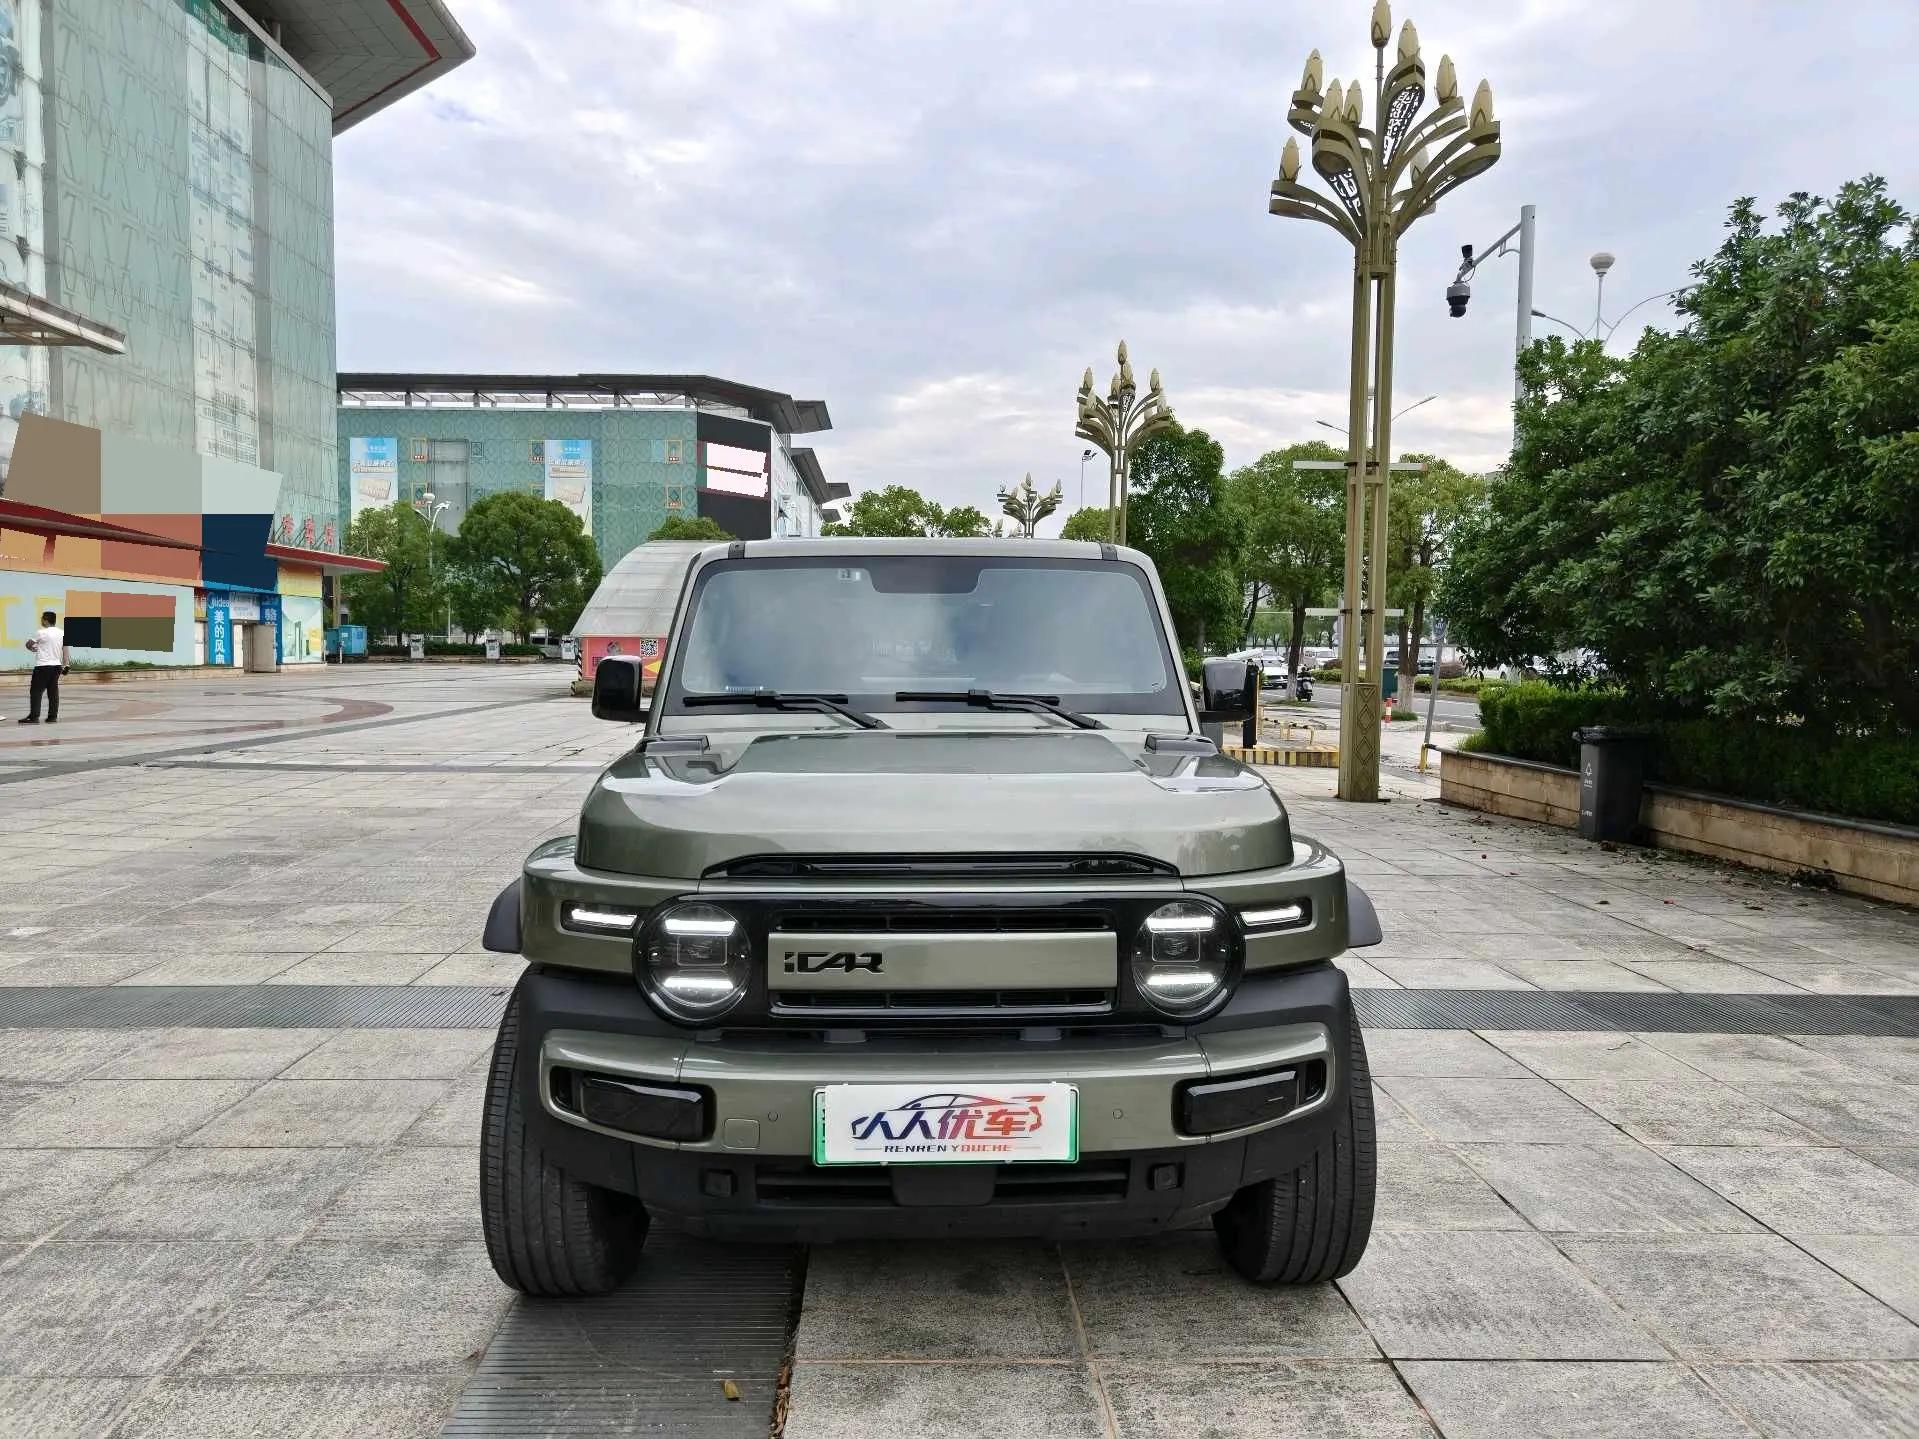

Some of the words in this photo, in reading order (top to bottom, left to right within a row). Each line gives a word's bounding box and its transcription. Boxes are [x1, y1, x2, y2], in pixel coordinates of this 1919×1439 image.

[853, 1109, 1032, 1140] 人人优车
[884, 1144, 947, 1153] RENREN
[951, 1144, 1012, 1153] YOUCHE
